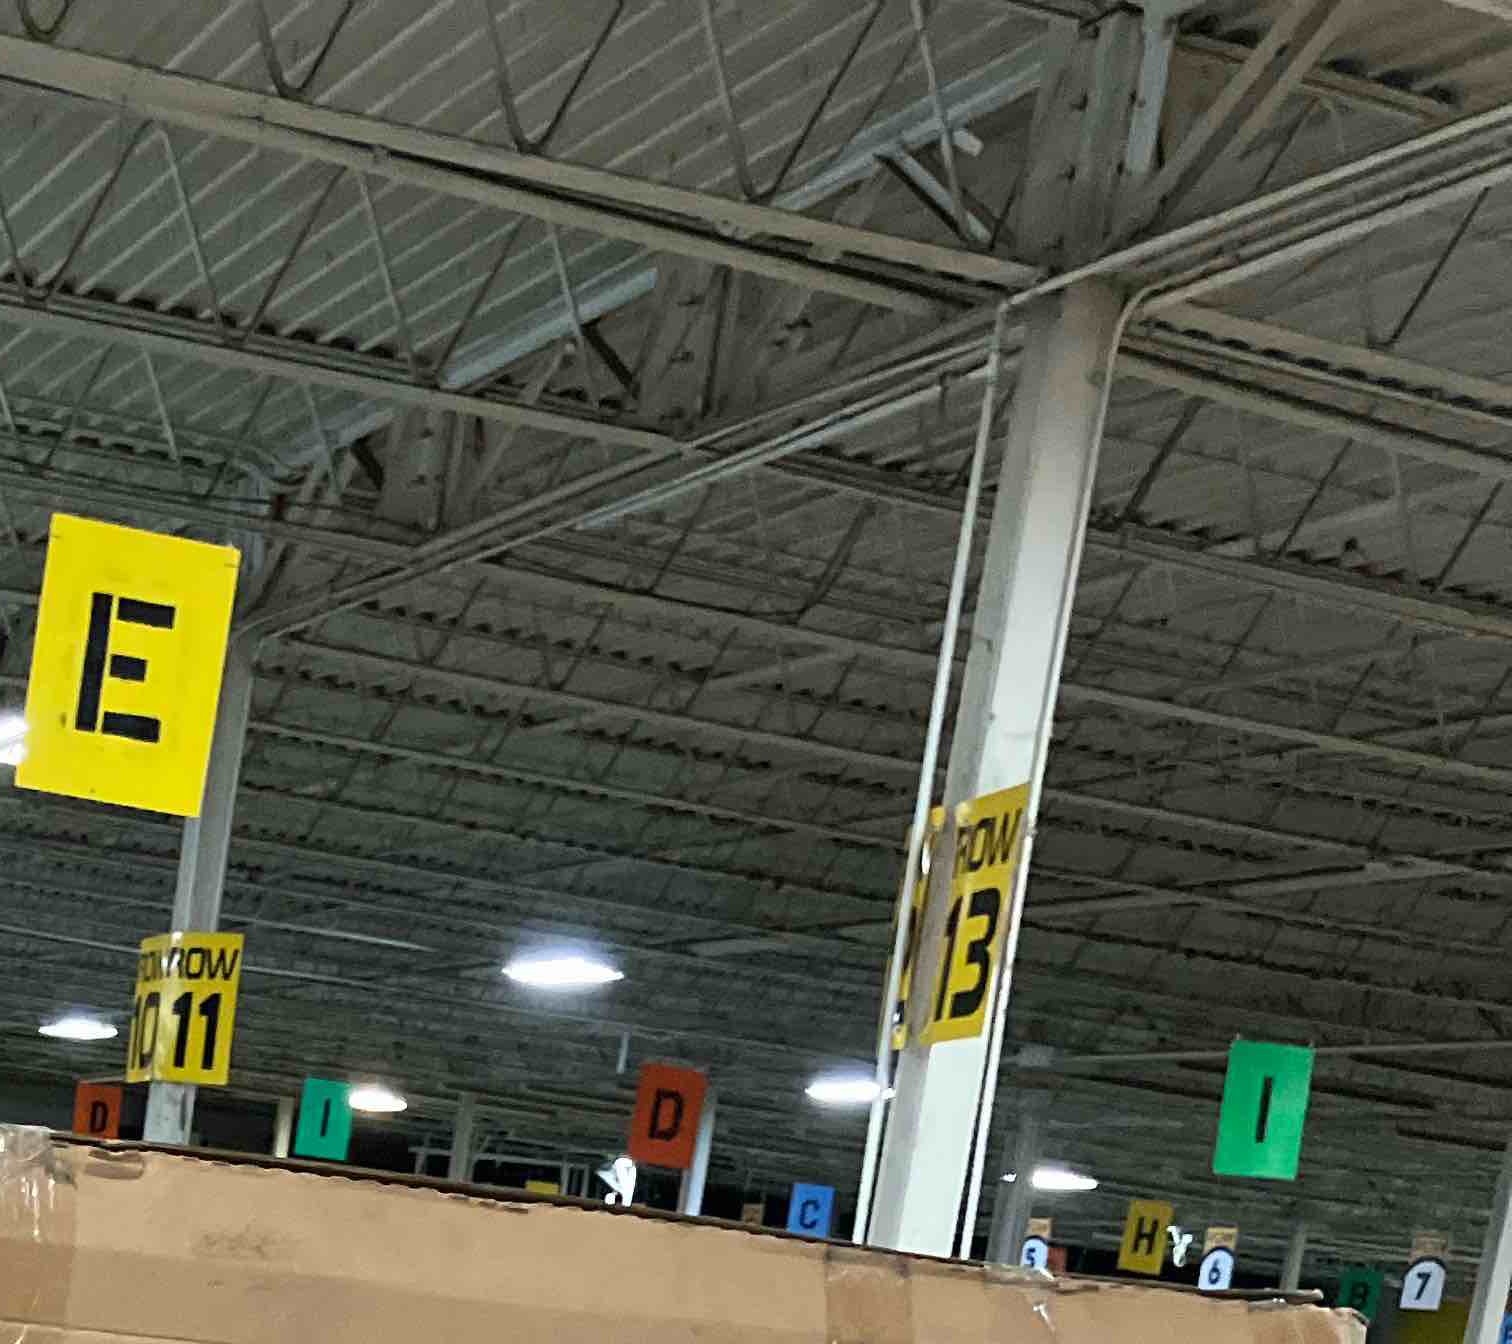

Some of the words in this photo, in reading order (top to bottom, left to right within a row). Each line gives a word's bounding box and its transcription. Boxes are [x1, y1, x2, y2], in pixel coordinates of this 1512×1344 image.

[75, 592, 176, 743] E
[167, 947, 240, 981] ROW
[934, 887, 1001, 1022] 13
[172, 991, 222, 1070] 11
[90, 1101, 109, 1134] D
[648, 1087, 684, 1141] D
[1255, 1076, 1275, 1144] I
[799, 1199, 821, 1230] C
[1132, 1216, 1159, 1256] H
[1208, 1259, 1221, 1285] 6
[1415, 1271, 1432, 1301] 7
